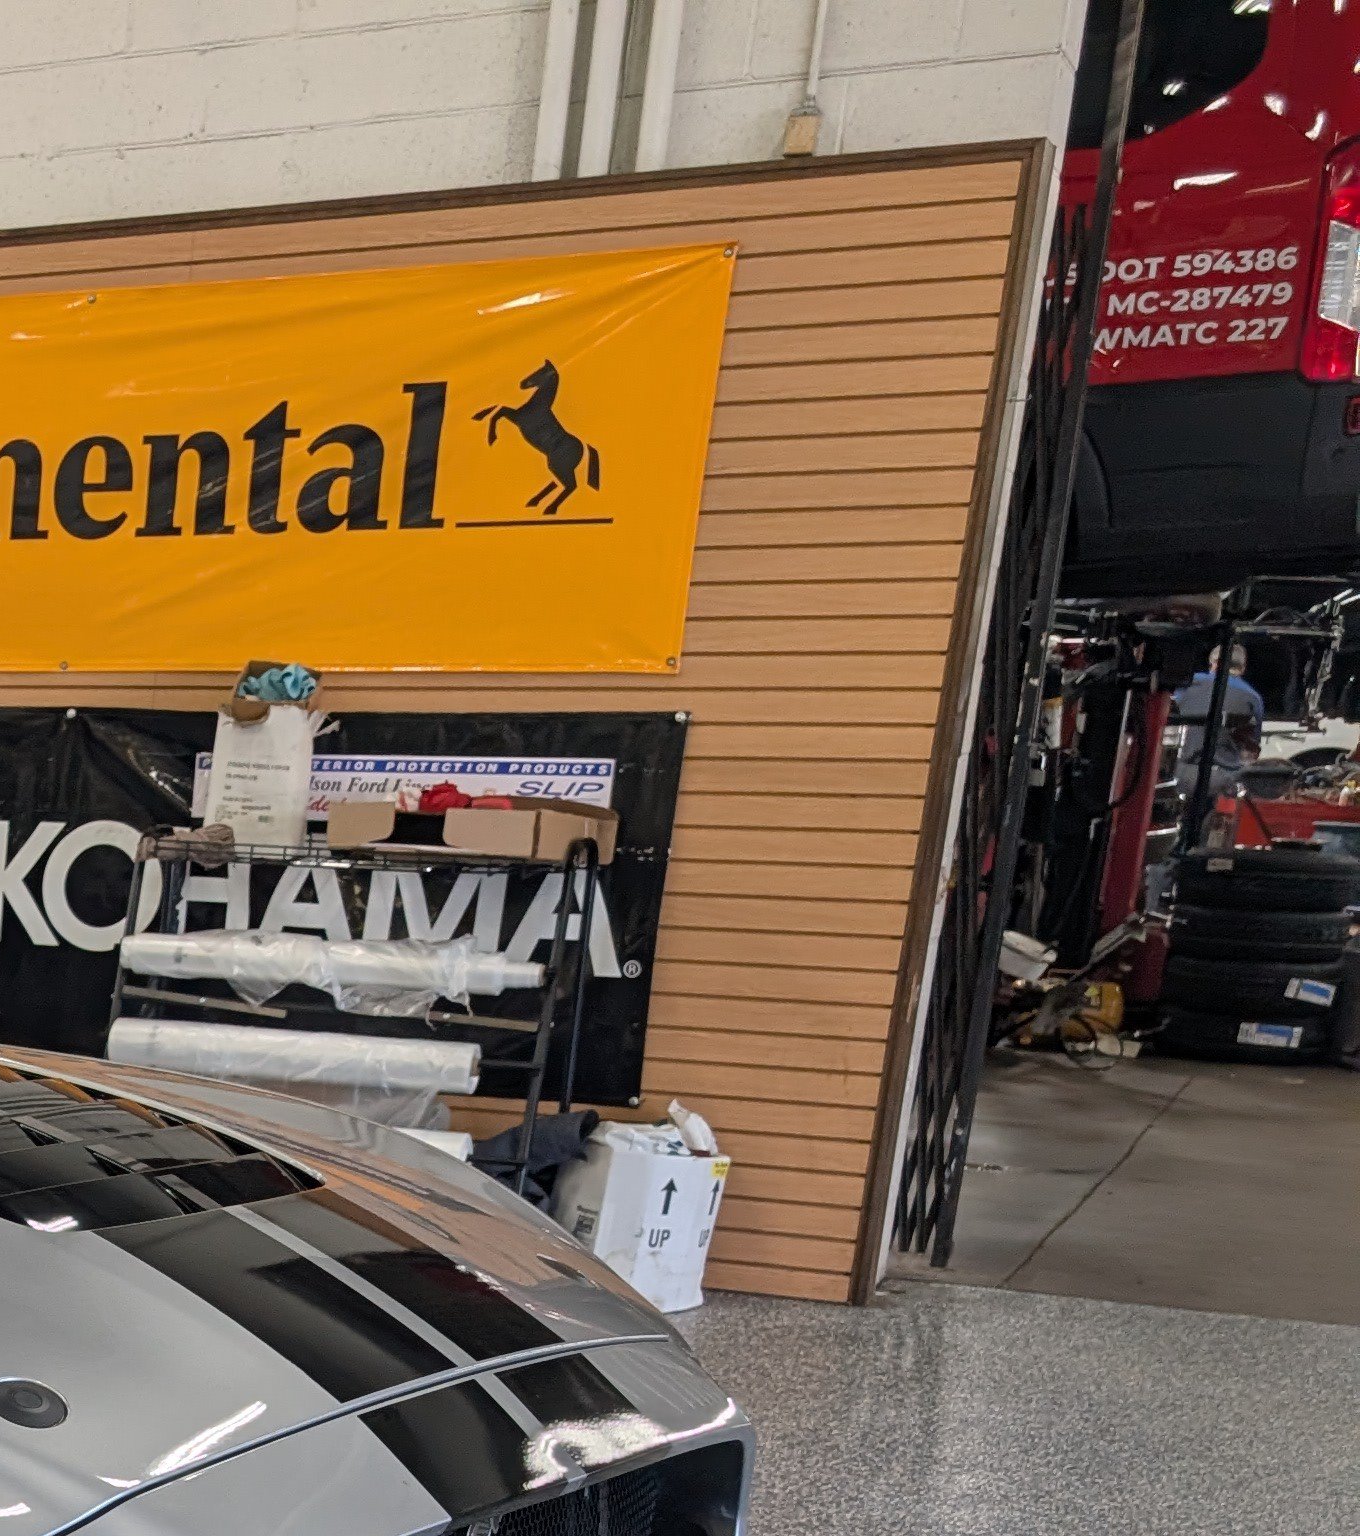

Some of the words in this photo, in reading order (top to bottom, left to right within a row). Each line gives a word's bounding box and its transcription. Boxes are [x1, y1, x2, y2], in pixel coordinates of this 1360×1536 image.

[1172, 246, 1298, 278] 594386
[1107, 281, 1293, 316] MC-287479
[1093, 320, 1218, 352] WMATC
[1225, 317, 1289, 344] 227
[312, 760, 376, 772] TERIOR
[385, 761, 498, 774] PROTECTION
[508, 763, 608, 775] PRODUCTS
[309, 775, 342, 792] lson
[347, 776, 390, 793] Ford
[515, 780, 604, 797] SLIP
[648, 1228, 672, 1248] UP
